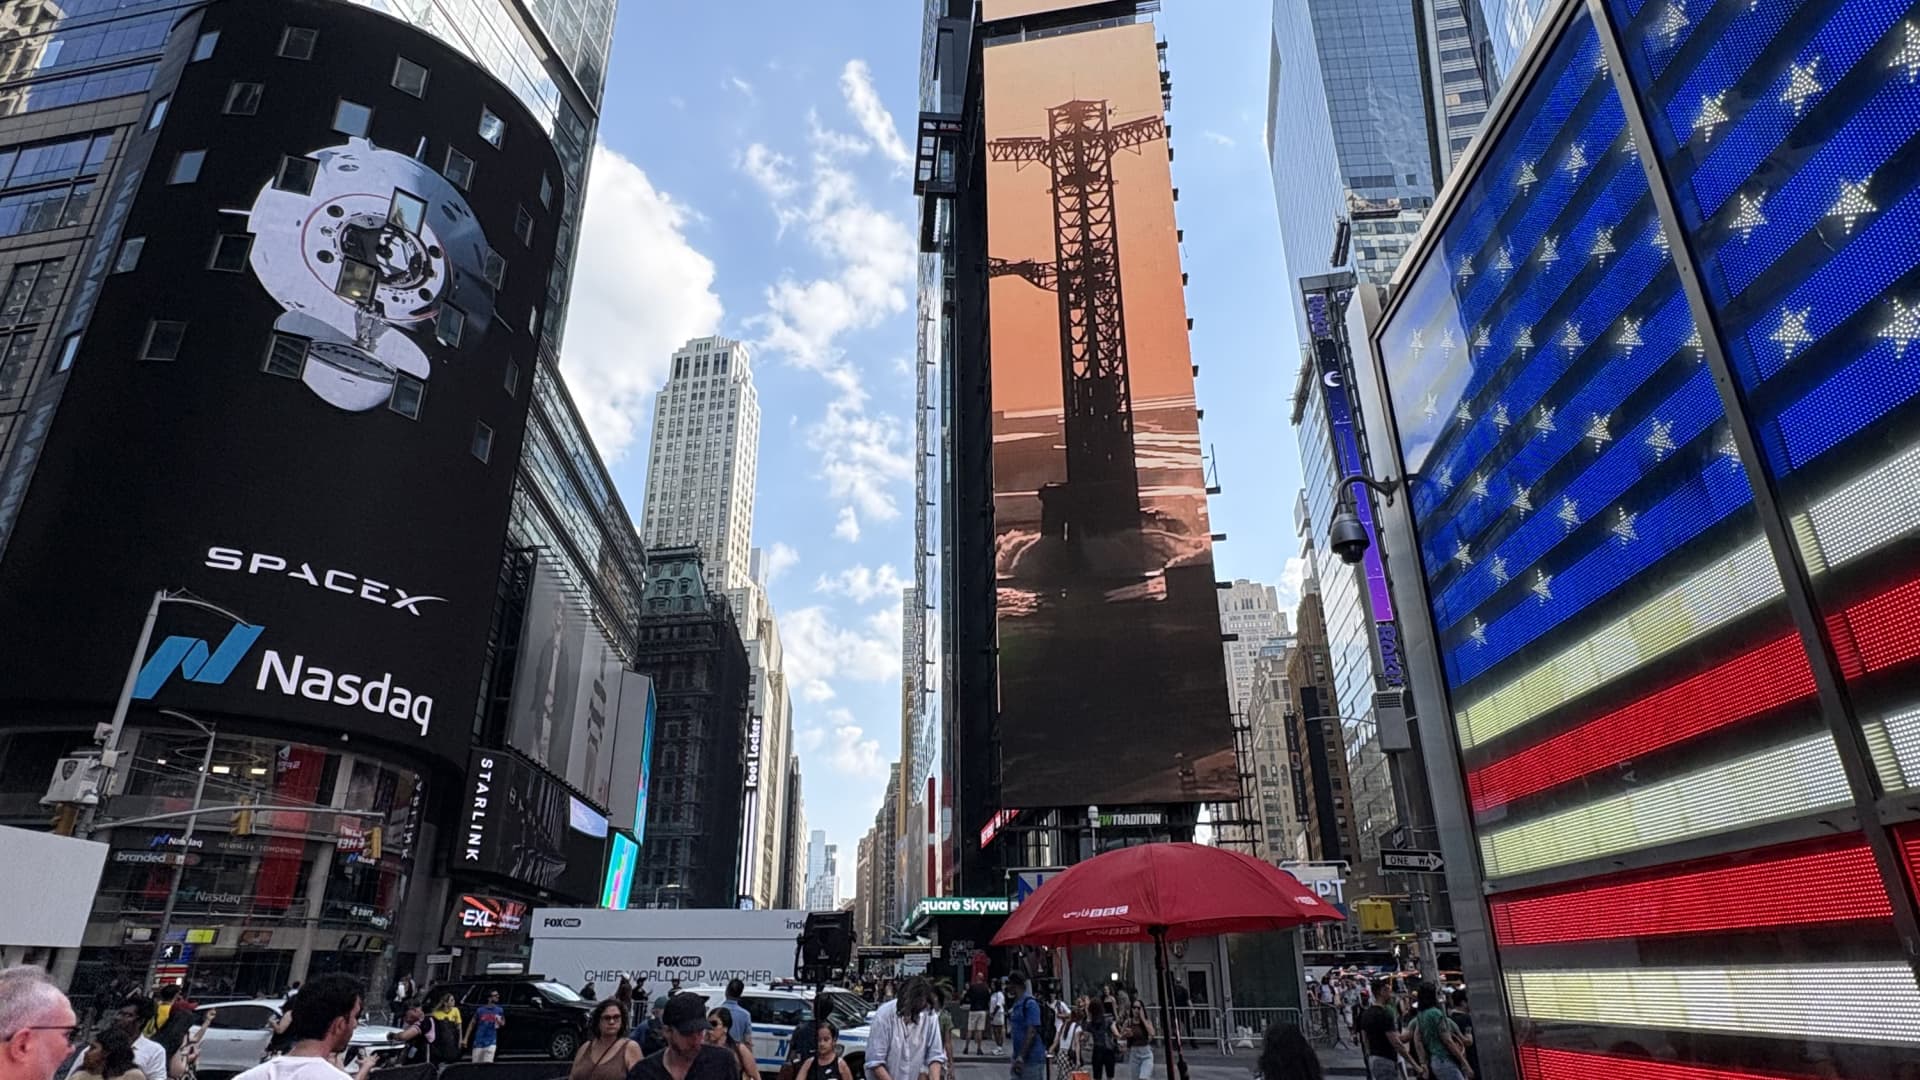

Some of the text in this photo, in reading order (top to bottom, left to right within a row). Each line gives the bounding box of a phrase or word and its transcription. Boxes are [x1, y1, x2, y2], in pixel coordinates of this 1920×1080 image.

[205, 546, 449, 617] SPACEX
[256, 649, 434, 738] Nasdaq
[745, 718, 761, 787] Foot Locker
[465, 757, 494, 862] STARLINK
[116, 851, 166, 863] branded
[1390, 856, 1438, 866] ONE WAY
[195, 890, 241, 904] Nasdaq
[463, 908, 492, 928] EXL
[1089, 905, 1128, 918] BBC
[544, 918, 563, 928] FOX
[656, 956, 701, 967] FOX ONE
[584, 969, 772, 982] CHIEF WORLD CUP WATCHER
